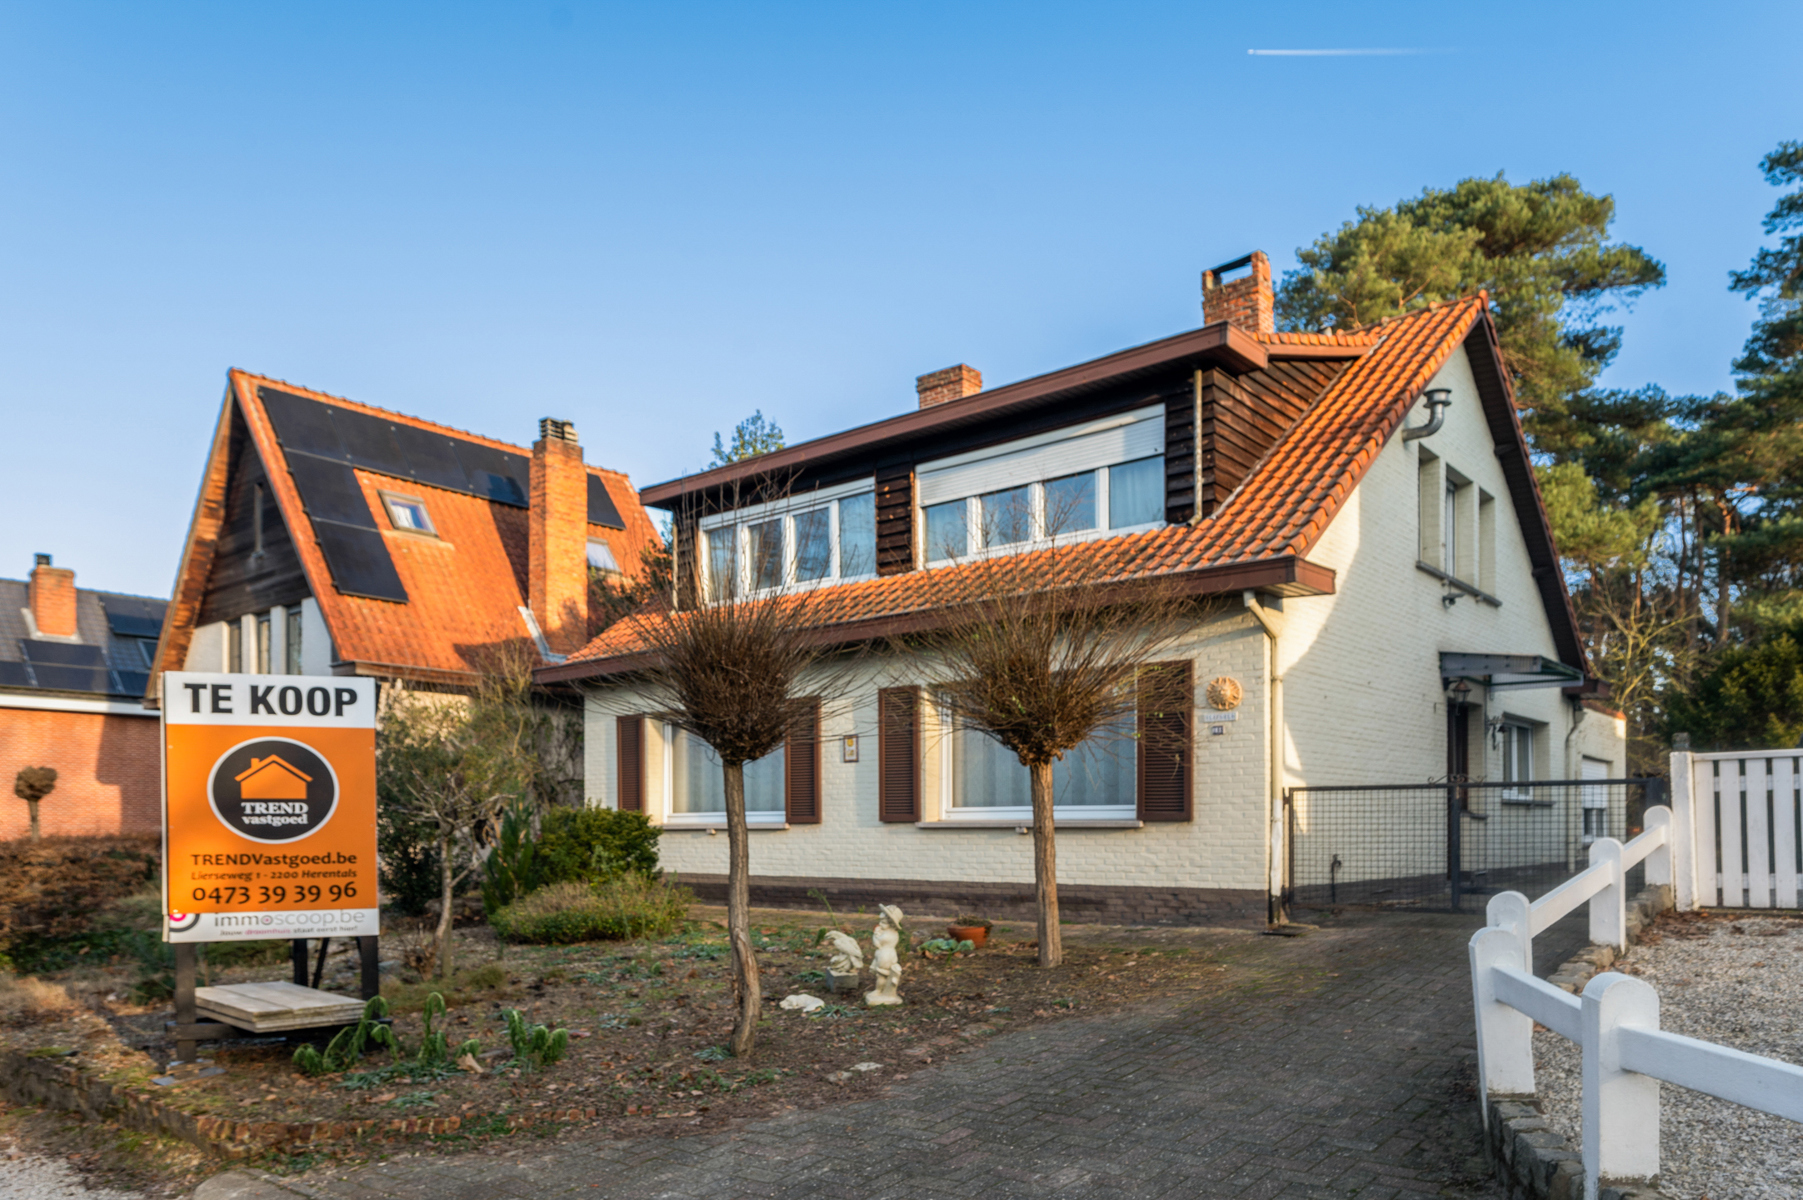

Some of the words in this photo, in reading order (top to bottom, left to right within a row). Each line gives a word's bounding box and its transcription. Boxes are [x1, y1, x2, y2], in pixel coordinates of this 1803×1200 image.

[184, 683, 233, 714] TE
[250, 684, 358, 717] KOOP
[241, 802, 309, 814] TREND
[241, 814, 309, 827] vastgoed
[190, 851, 358, 868] TRENDVastgoed.be
[191, 870, 253, 882] Lierseweg
[270, 871, 299, 880] 2200
[301, 869, 358, 879] Herentals
[192, 886, 251, 905] 0473
[258, 886, 287, 904] 39
[293, 885, 322, 903] 39
[329, 881, 358, 902] 96
[214, 908, 366, 926] immoscoop.be
